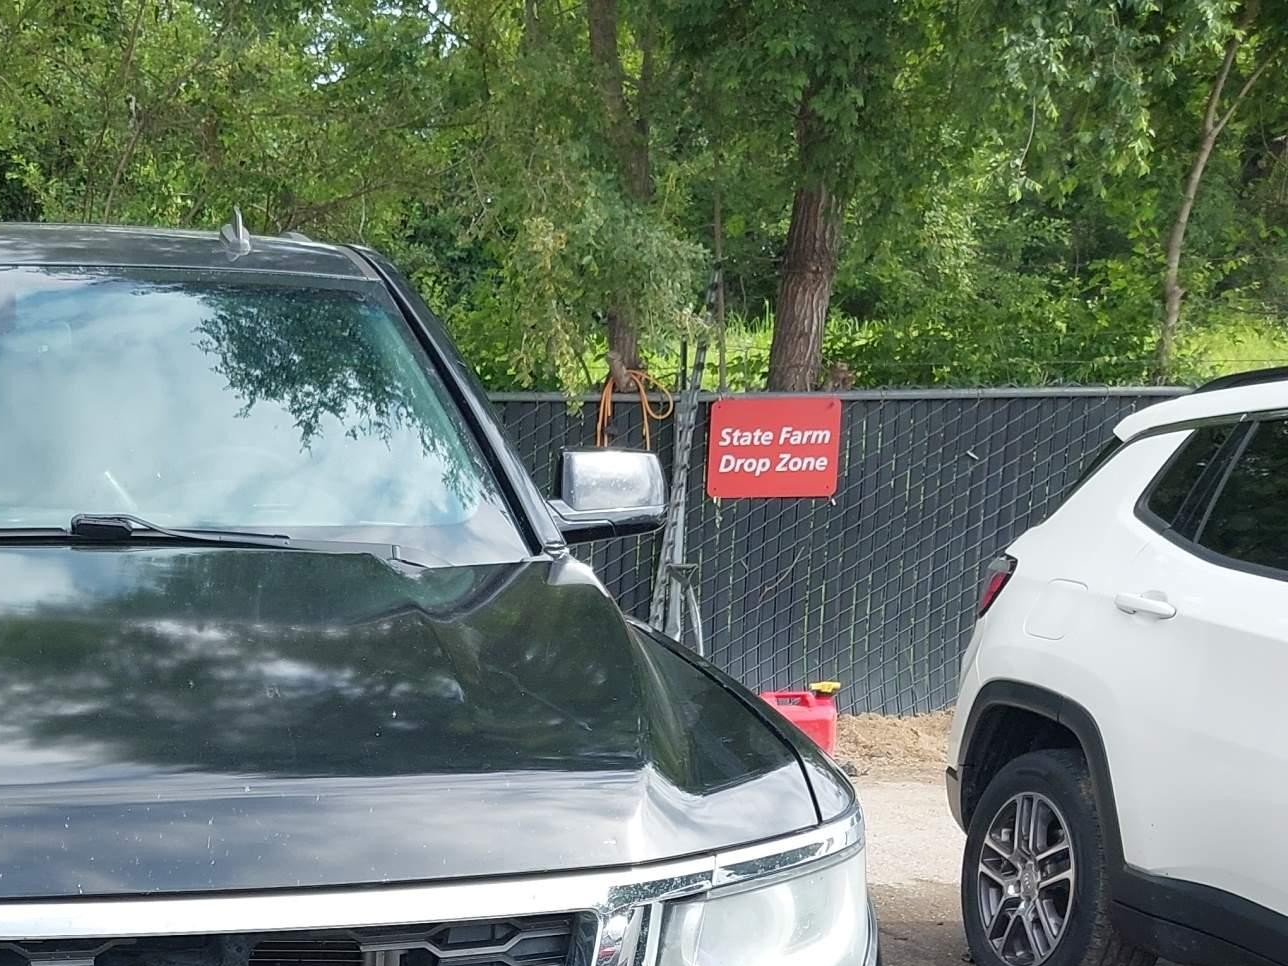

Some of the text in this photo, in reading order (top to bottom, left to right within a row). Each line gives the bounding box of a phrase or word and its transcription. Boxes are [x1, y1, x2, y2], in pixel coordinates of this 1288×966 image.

[718, 427, 831, 446] State Farm
[718, 454, 828, 476] Drop Zone
